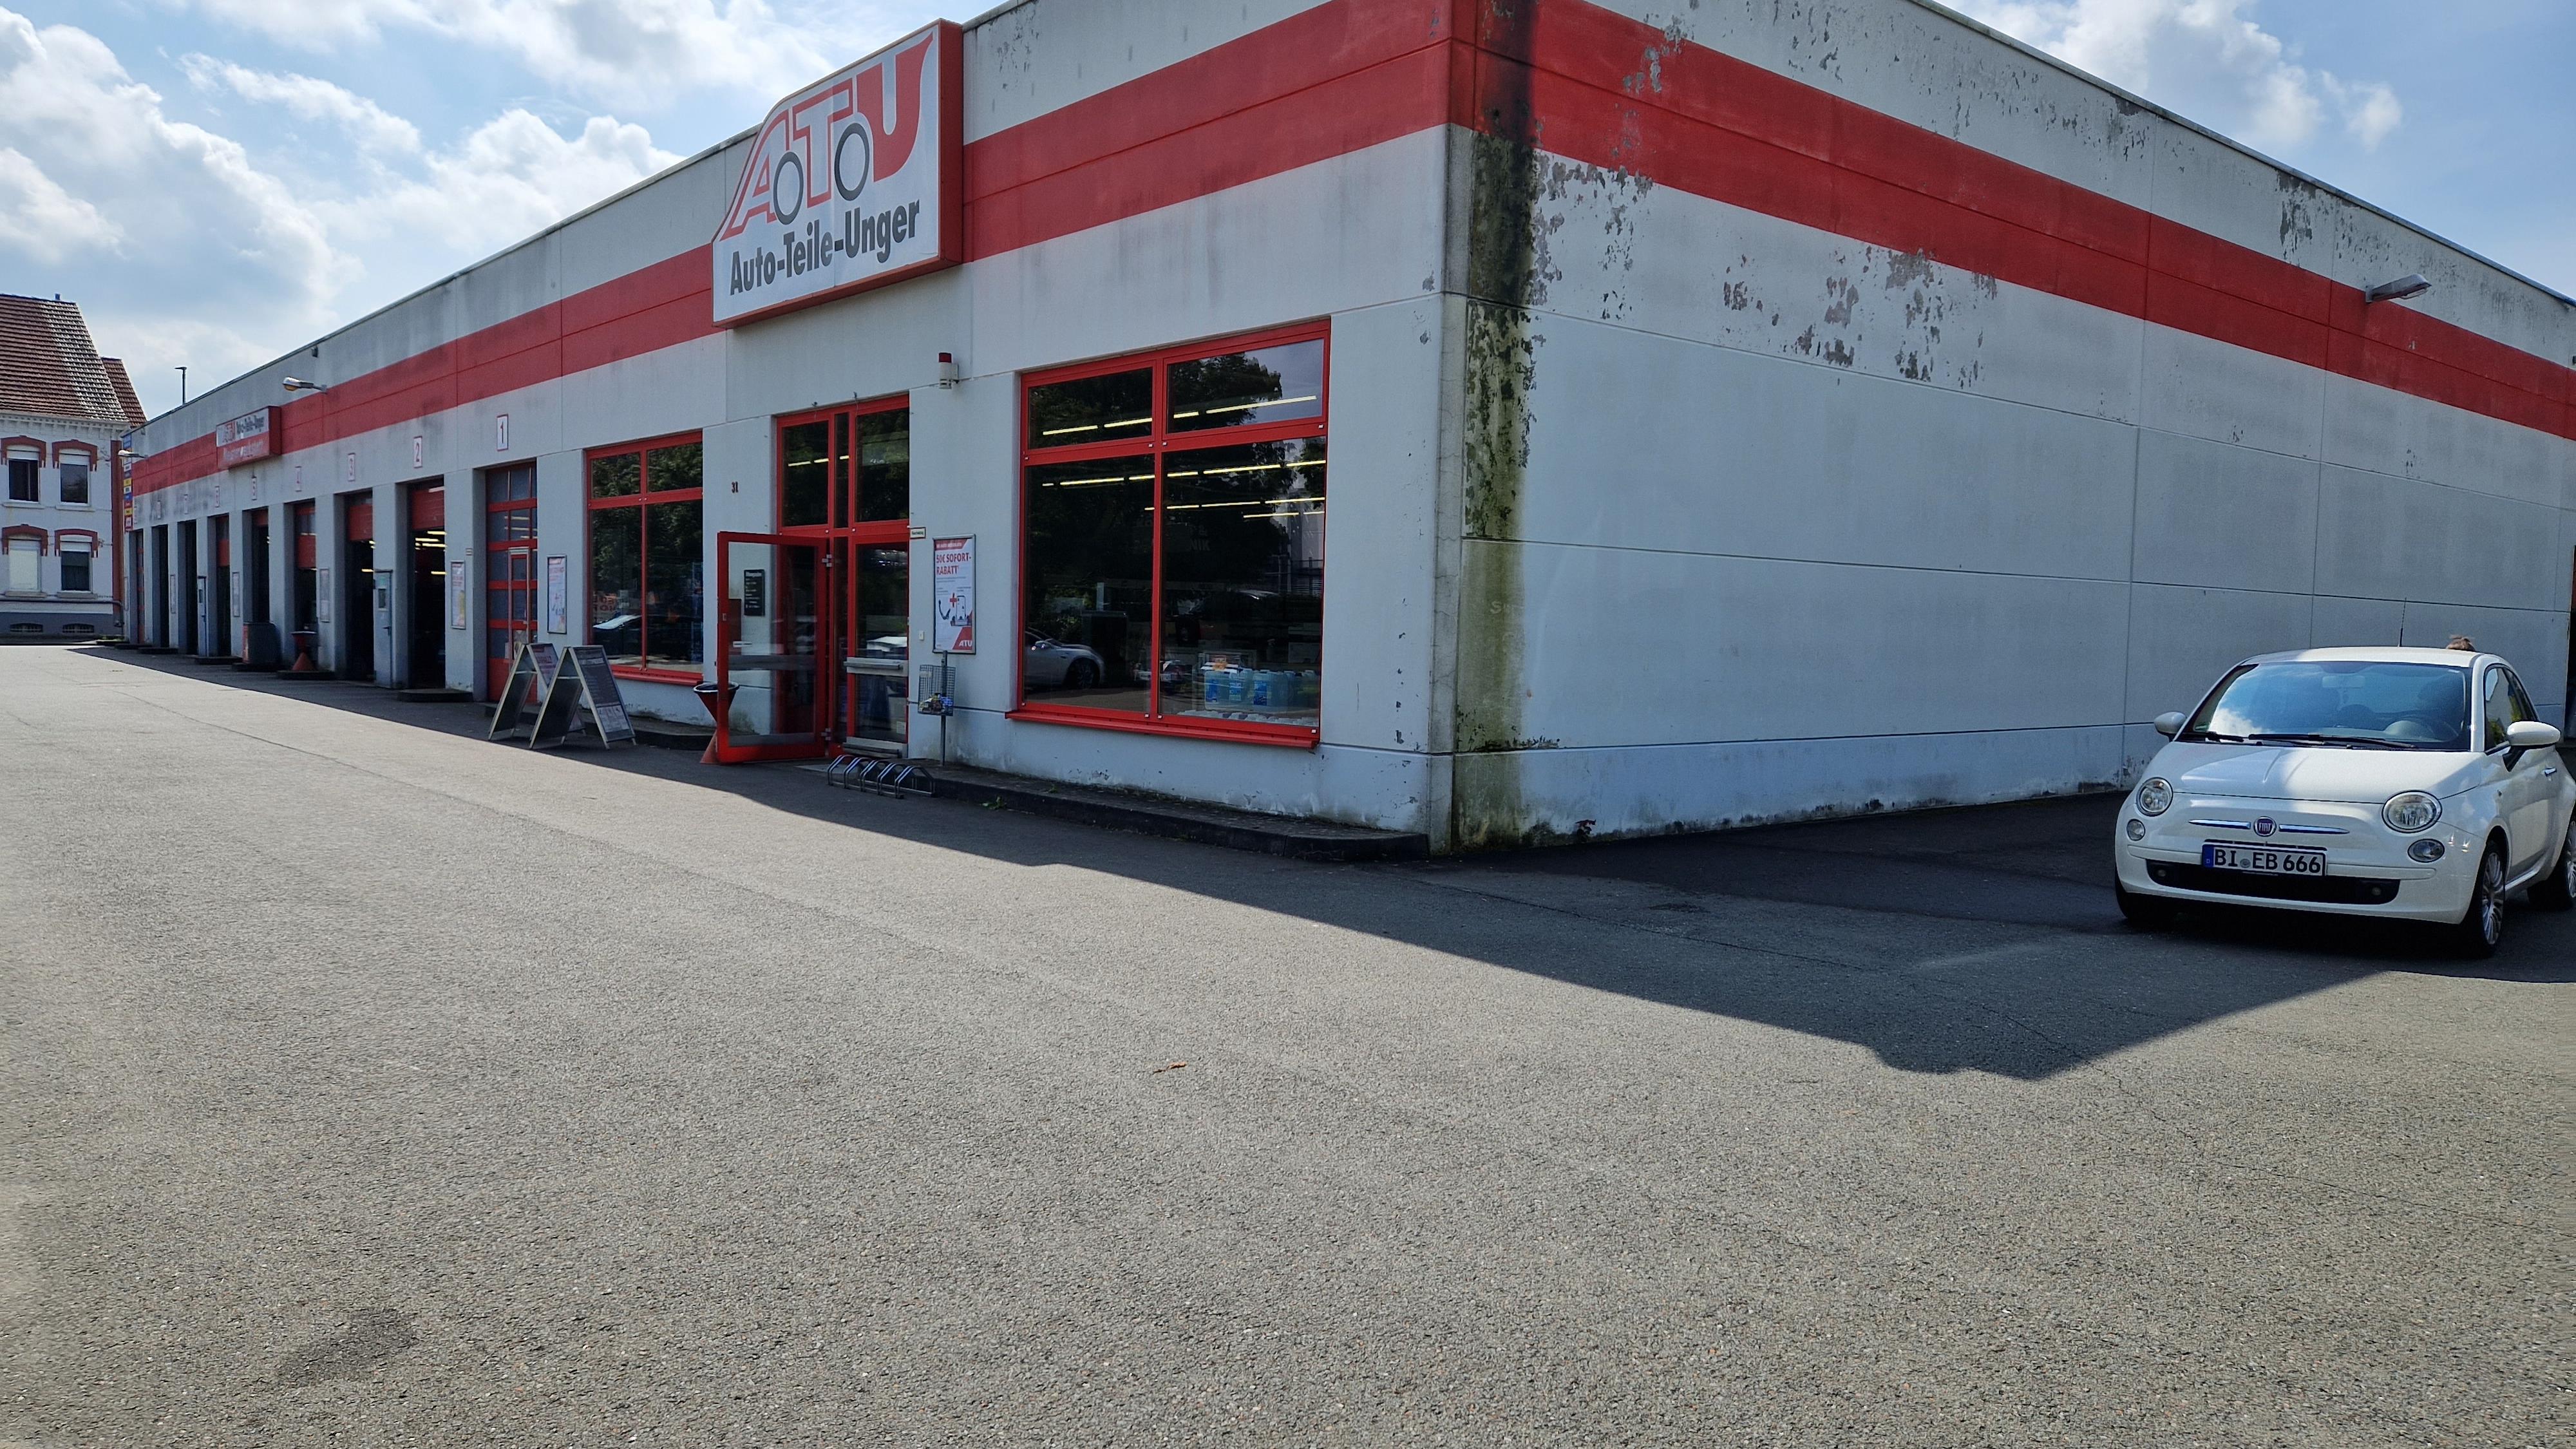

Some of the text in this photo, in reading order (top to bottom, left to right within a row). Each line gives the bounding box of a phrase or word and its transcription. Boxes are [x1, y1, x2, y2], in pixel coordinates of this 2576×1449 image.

[719, 32, 933, 242] ATU
[729, 198, 920, 296] Auto-Teile-Unger
[415, 442, 420, 462] 2
[731, 481, 739, 494] 31
[946, 553, 972, 564] SOFORT-
[2259, 822, 2272, 832] FIAT
[2214, 849, 2322, 874] BI EB 666
